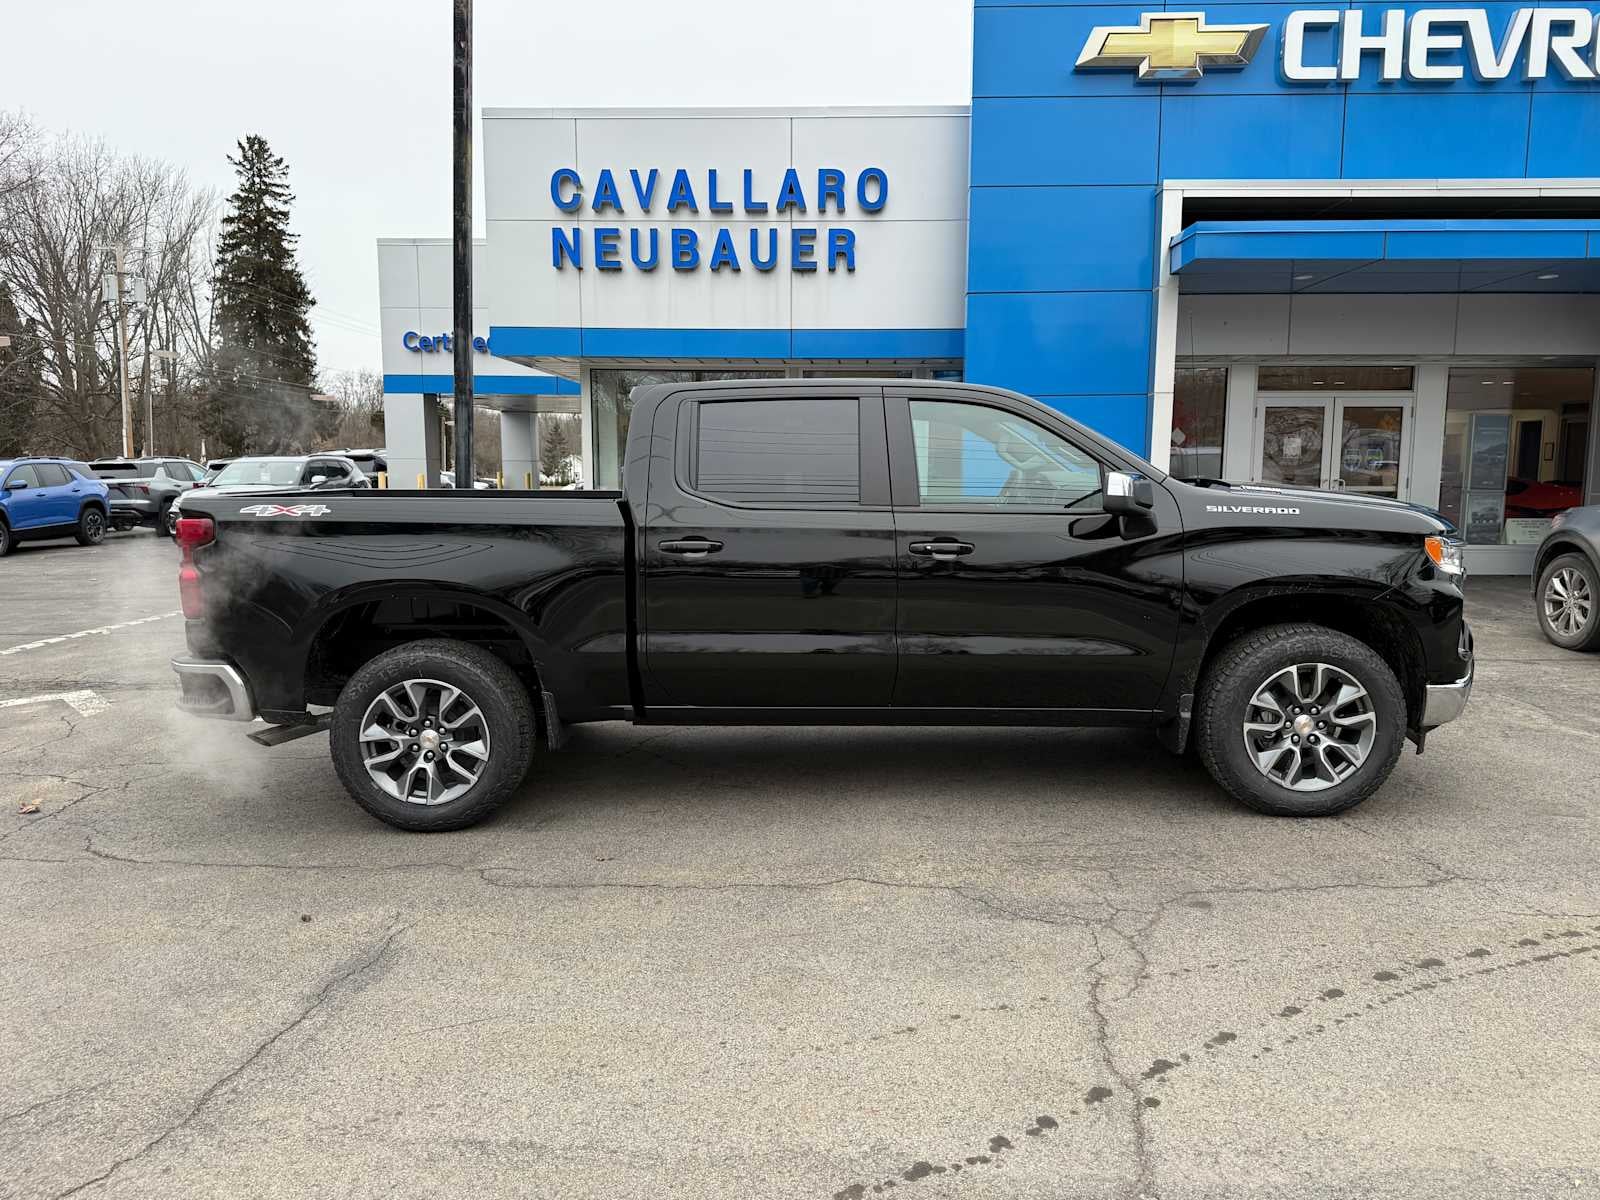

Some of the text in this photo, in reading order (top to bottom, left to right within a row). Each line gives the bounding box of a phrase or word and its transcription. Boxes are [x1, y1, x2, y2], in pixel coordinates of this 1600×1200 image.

[1281, 8, 1600, 82] CHEVR
[550, 167, 889, 213] CAVALLARO
[551, 227, 857, 272] NEUBAUER
[403, 331, 491, 352] Certe
[1206, 505, 1300, 515] SILVERADO
